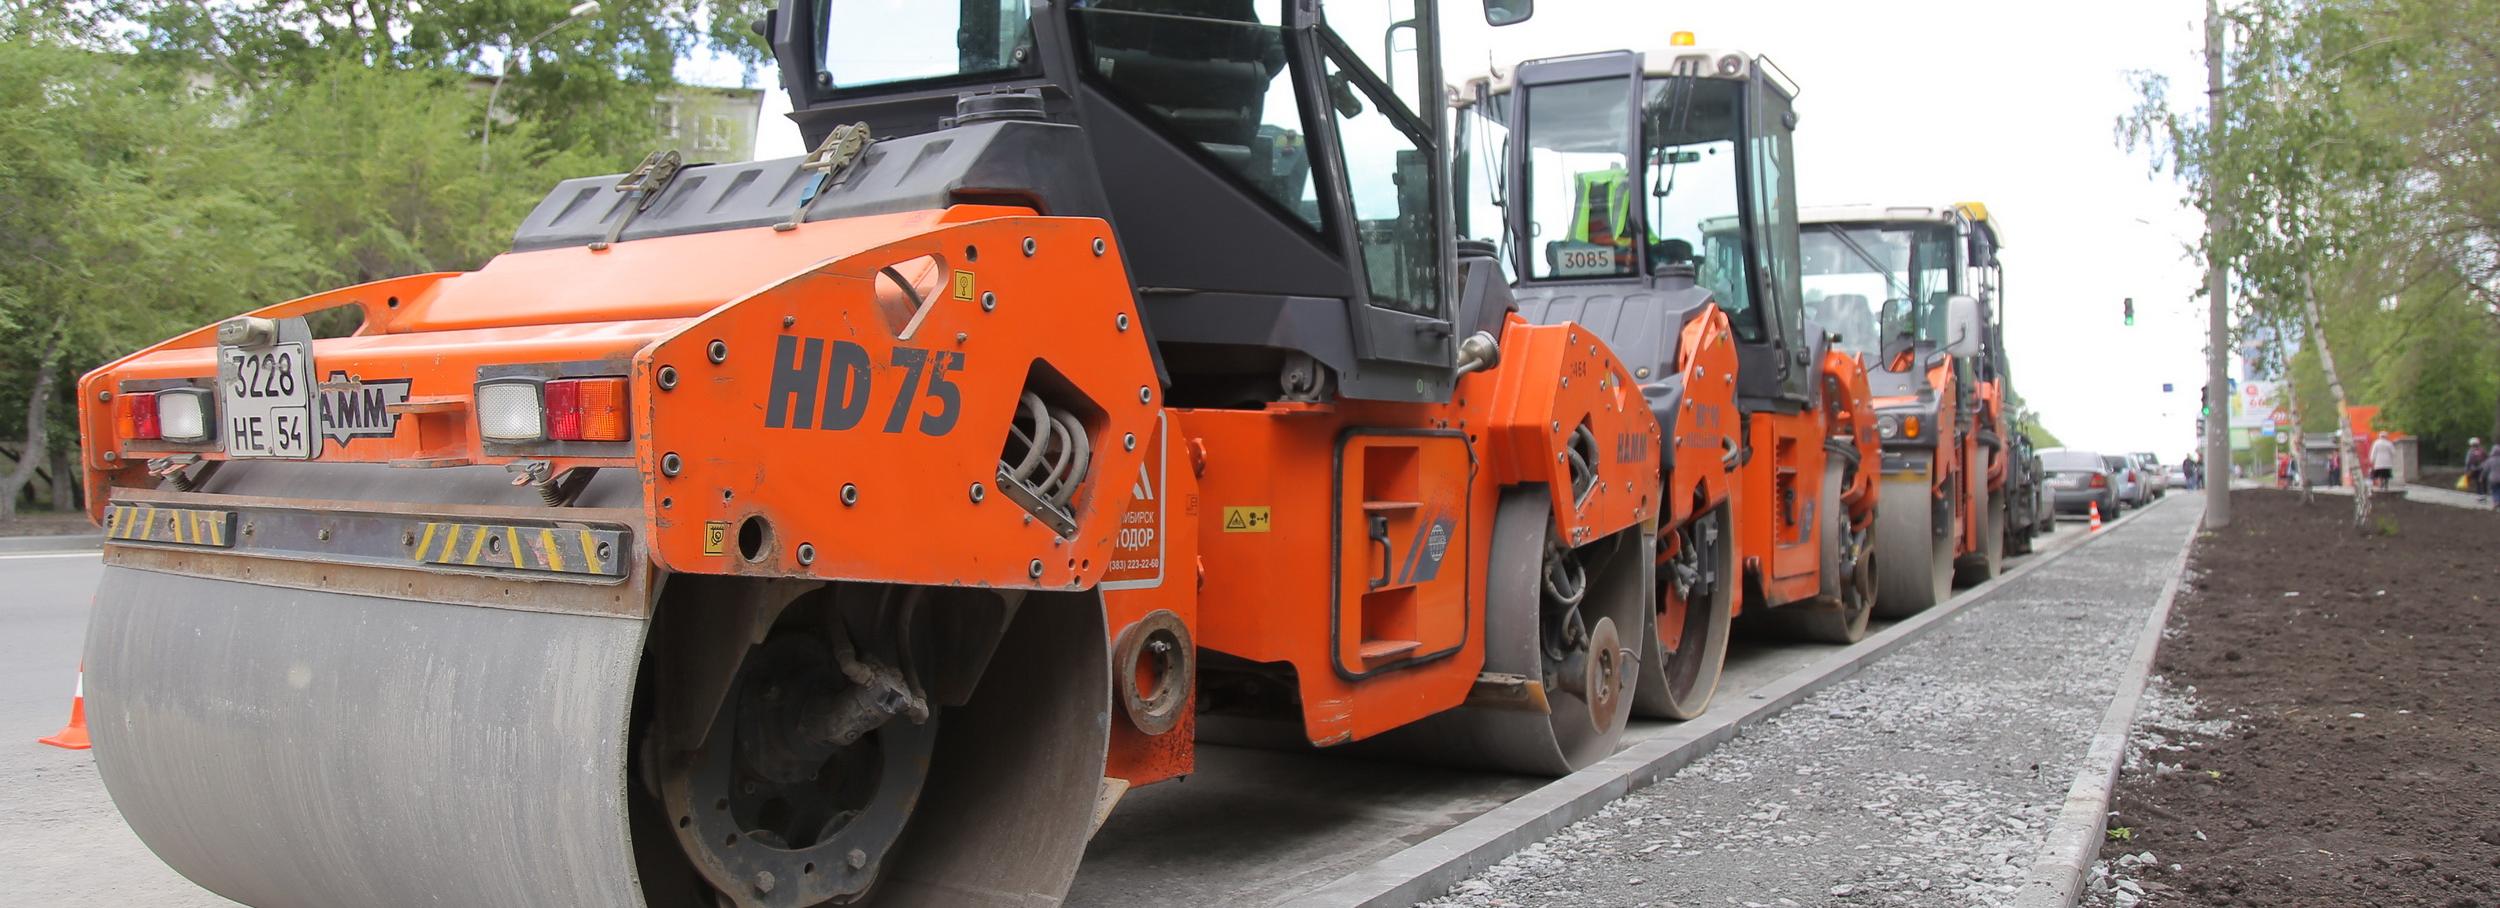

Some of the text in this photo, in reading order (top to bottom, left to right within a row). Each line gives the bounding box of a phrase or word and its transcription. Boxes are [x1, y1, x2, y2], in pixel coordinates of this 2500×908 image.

[1564, 251, 1608, 269] 3085
[233, 352, 294, 399] 3228
[764, 335, 965, 437] HD 75
[320, 389, 389, 429] AMM
[278, 415, 302, 450] 54
[1109, 560, 1127, 572] (383)
